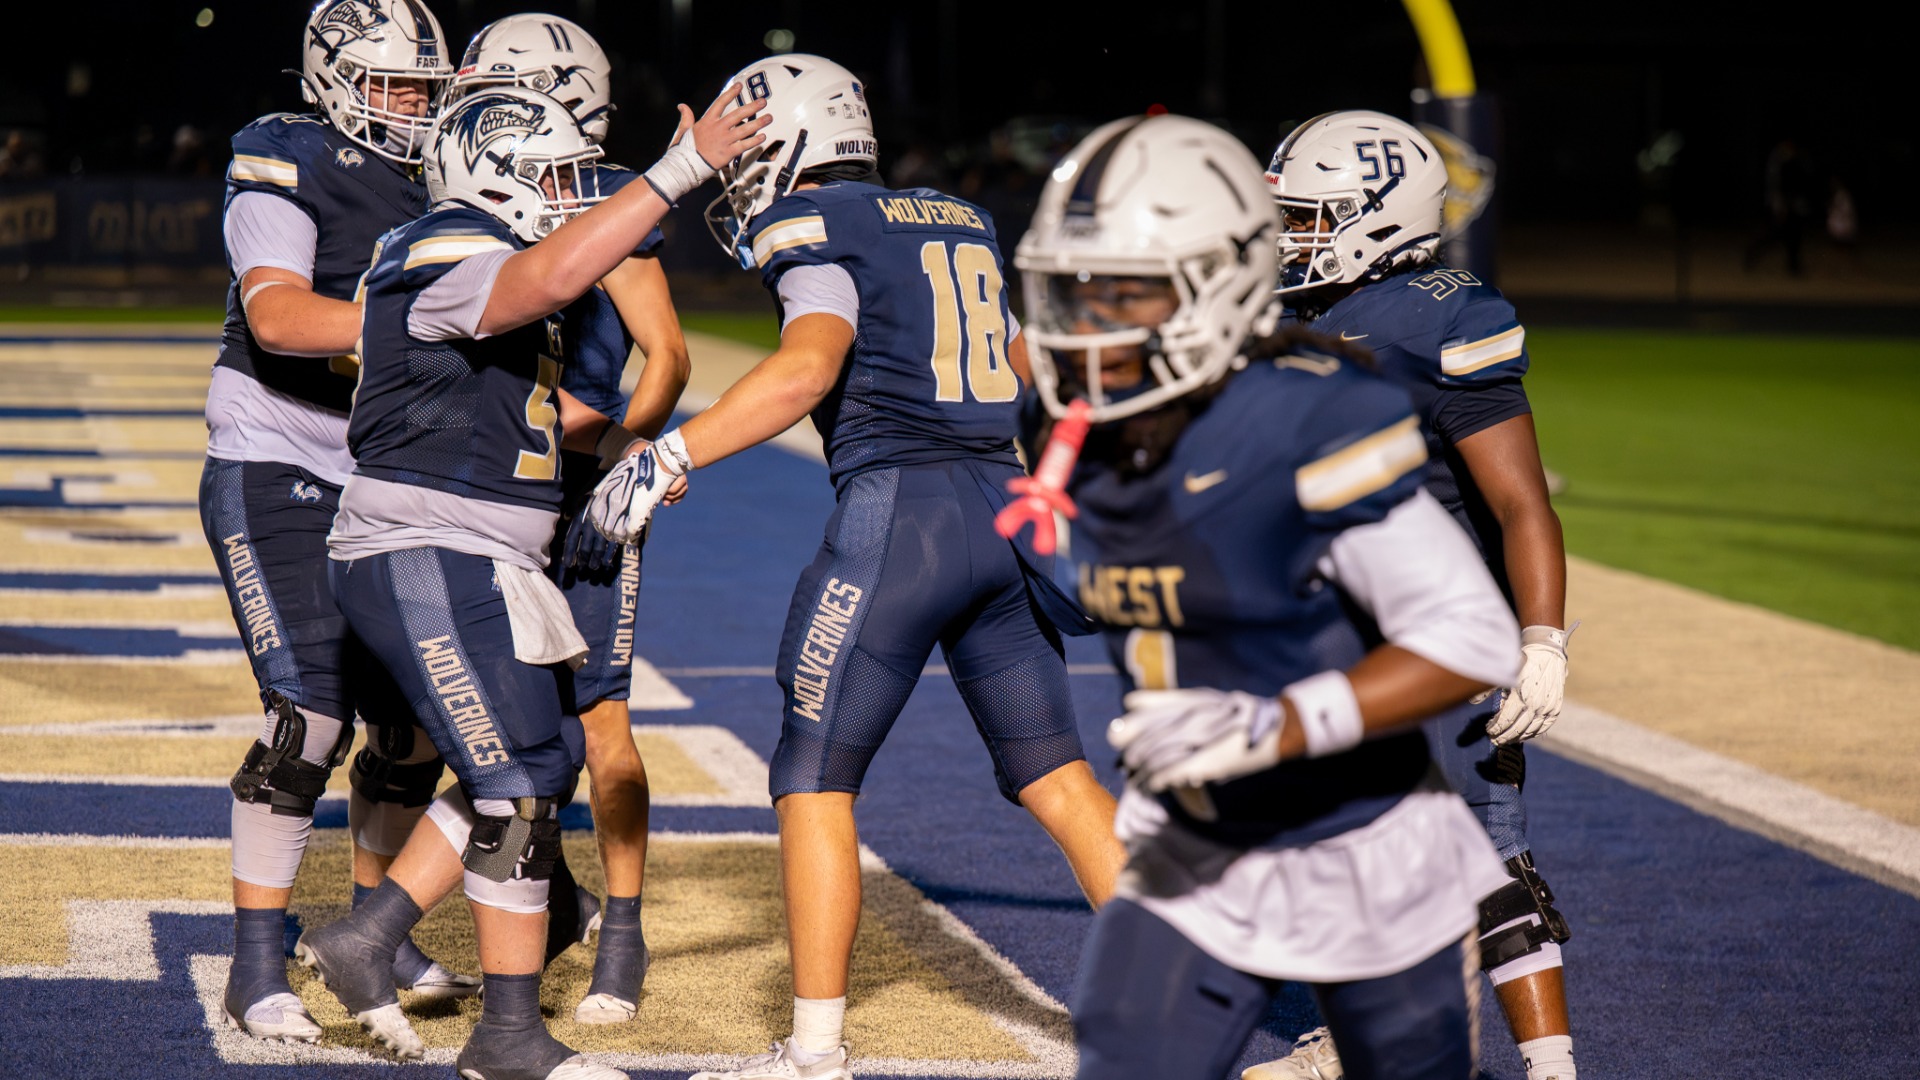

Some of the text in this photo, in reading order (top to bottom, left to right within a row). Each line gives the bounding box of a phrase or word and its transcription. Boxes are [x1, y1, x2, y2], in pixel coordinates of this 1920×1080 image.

[415, 57, 440, 68] FAST
[543, 23, 574, 53] 11
[876, 197, 986, 231] WOLVERINES
[1353, 139, 1407, 184] 56
[920, 240, 1019, 403] 18
[513, 352, 565, 480] 5
[222, 532, 281, 657] WOLVERINES
[609, 539, 640, 667] WOLVERINE
[793, 577, 863, 723] WOLVERINES
[1078, 563, 1186, 628] WEST
[417, 634, 510, 767] WOLVERINES
